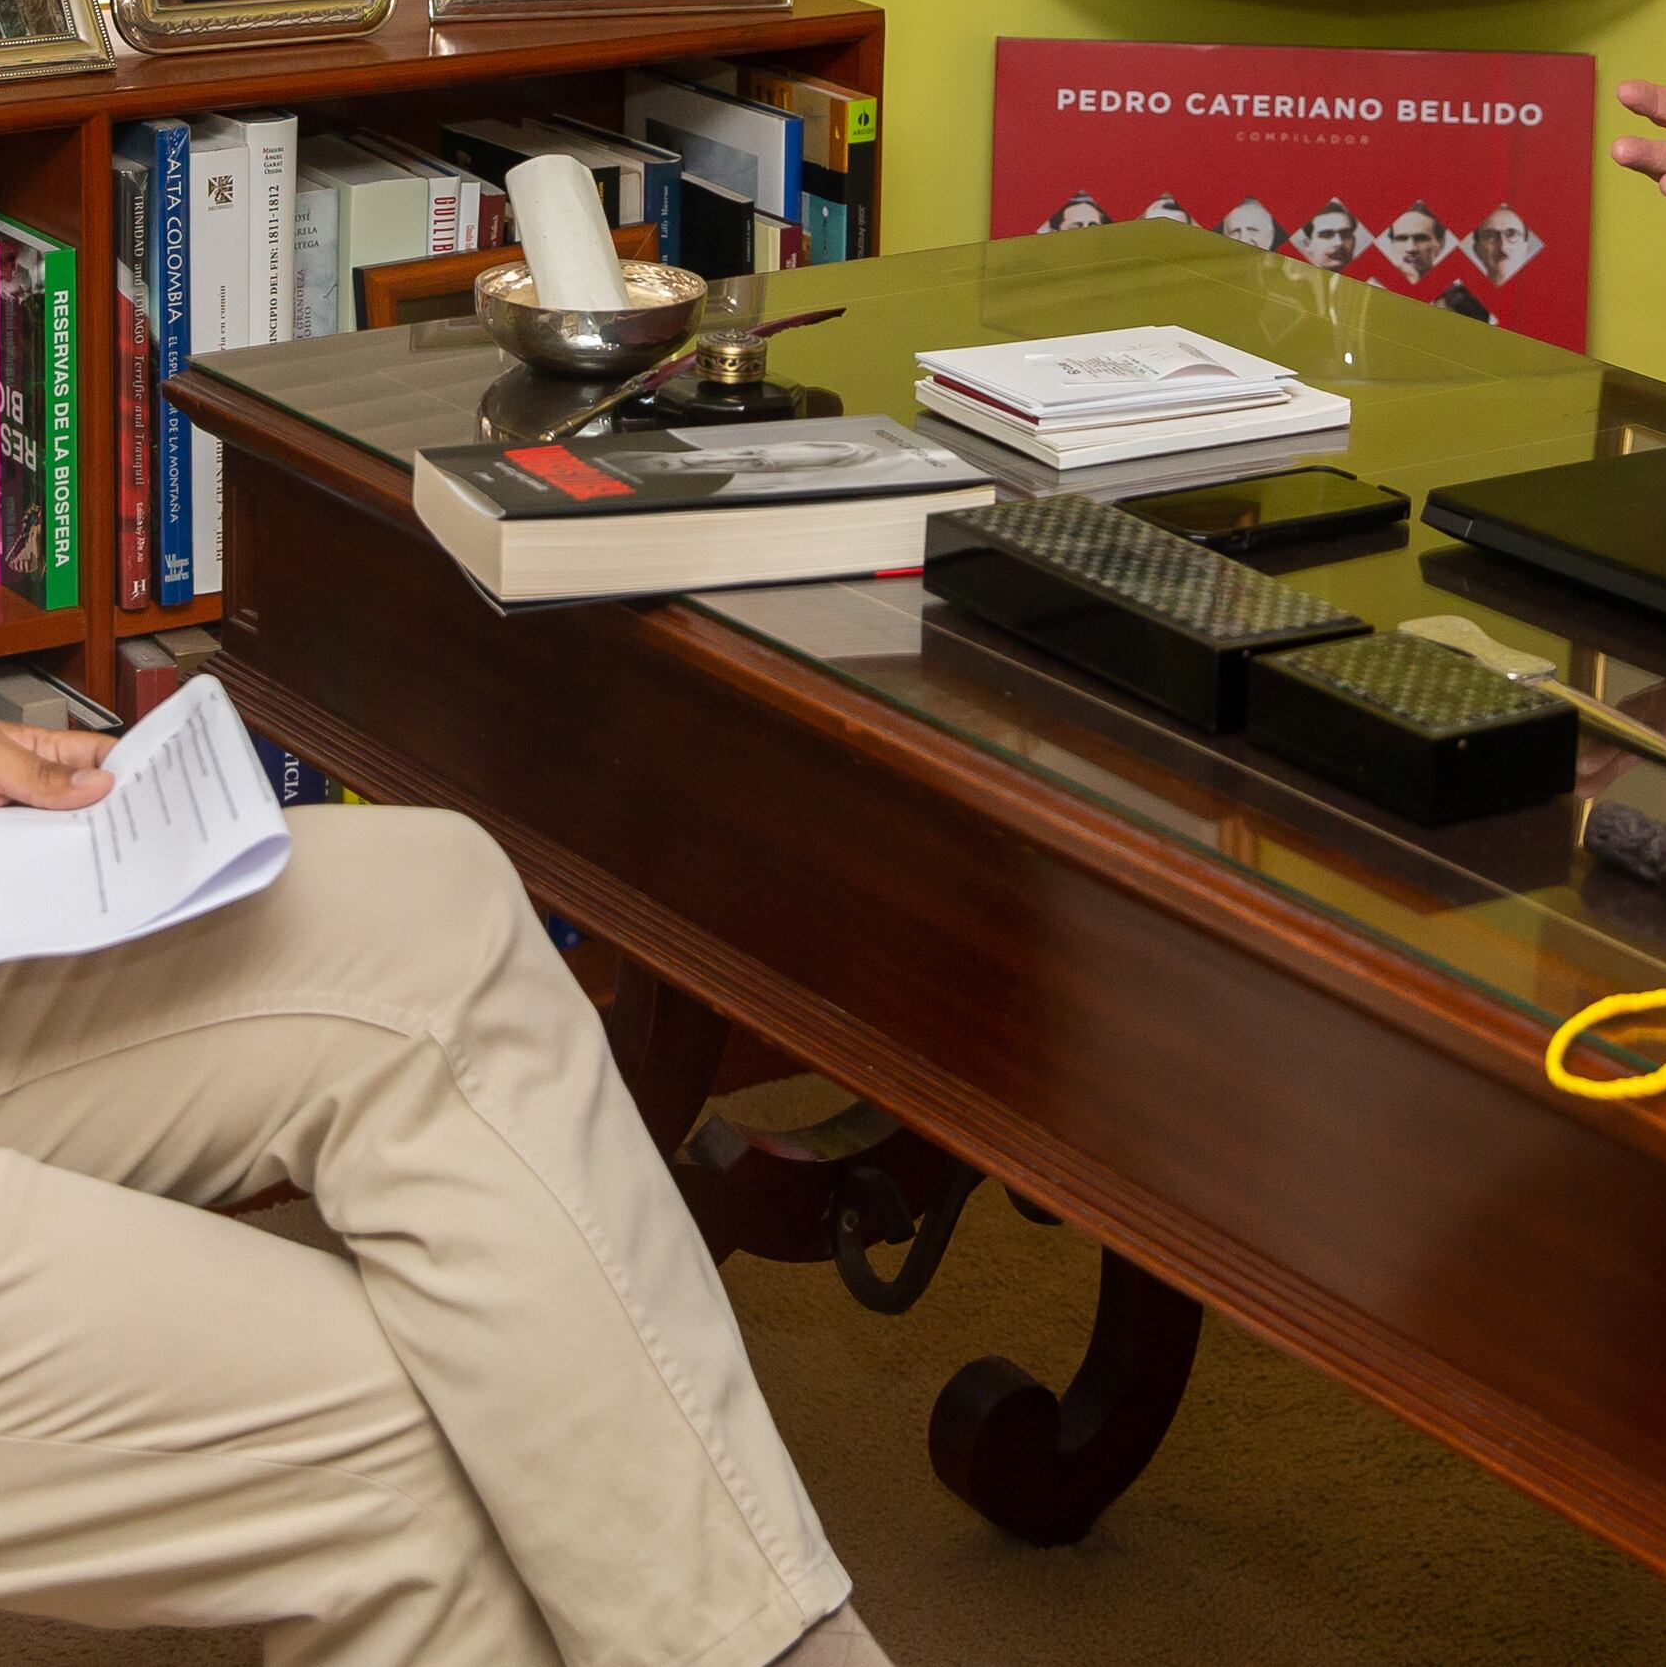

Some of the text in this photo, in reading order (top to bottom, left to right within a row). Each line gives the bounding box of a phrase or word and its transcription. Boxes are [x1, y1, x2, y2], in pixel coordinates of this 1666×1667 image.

[1057, 88, 1544, 127] PEDRO CATERIANO BELLIDO
[1235, 130, 1372, 146] COMPILADOR
[268, 185, 280, 294] DEL FIN: 1811-1812
[53, 289, 70, 567] RESERVAS DE LA BIOSFERA
[133, 195, 145, 485] TRINIDAD and TOBAGO Terrific and Tranquil
[167, 157, 183, 523] ALTA COLOMBIA EL DE LA MONTAÑA
